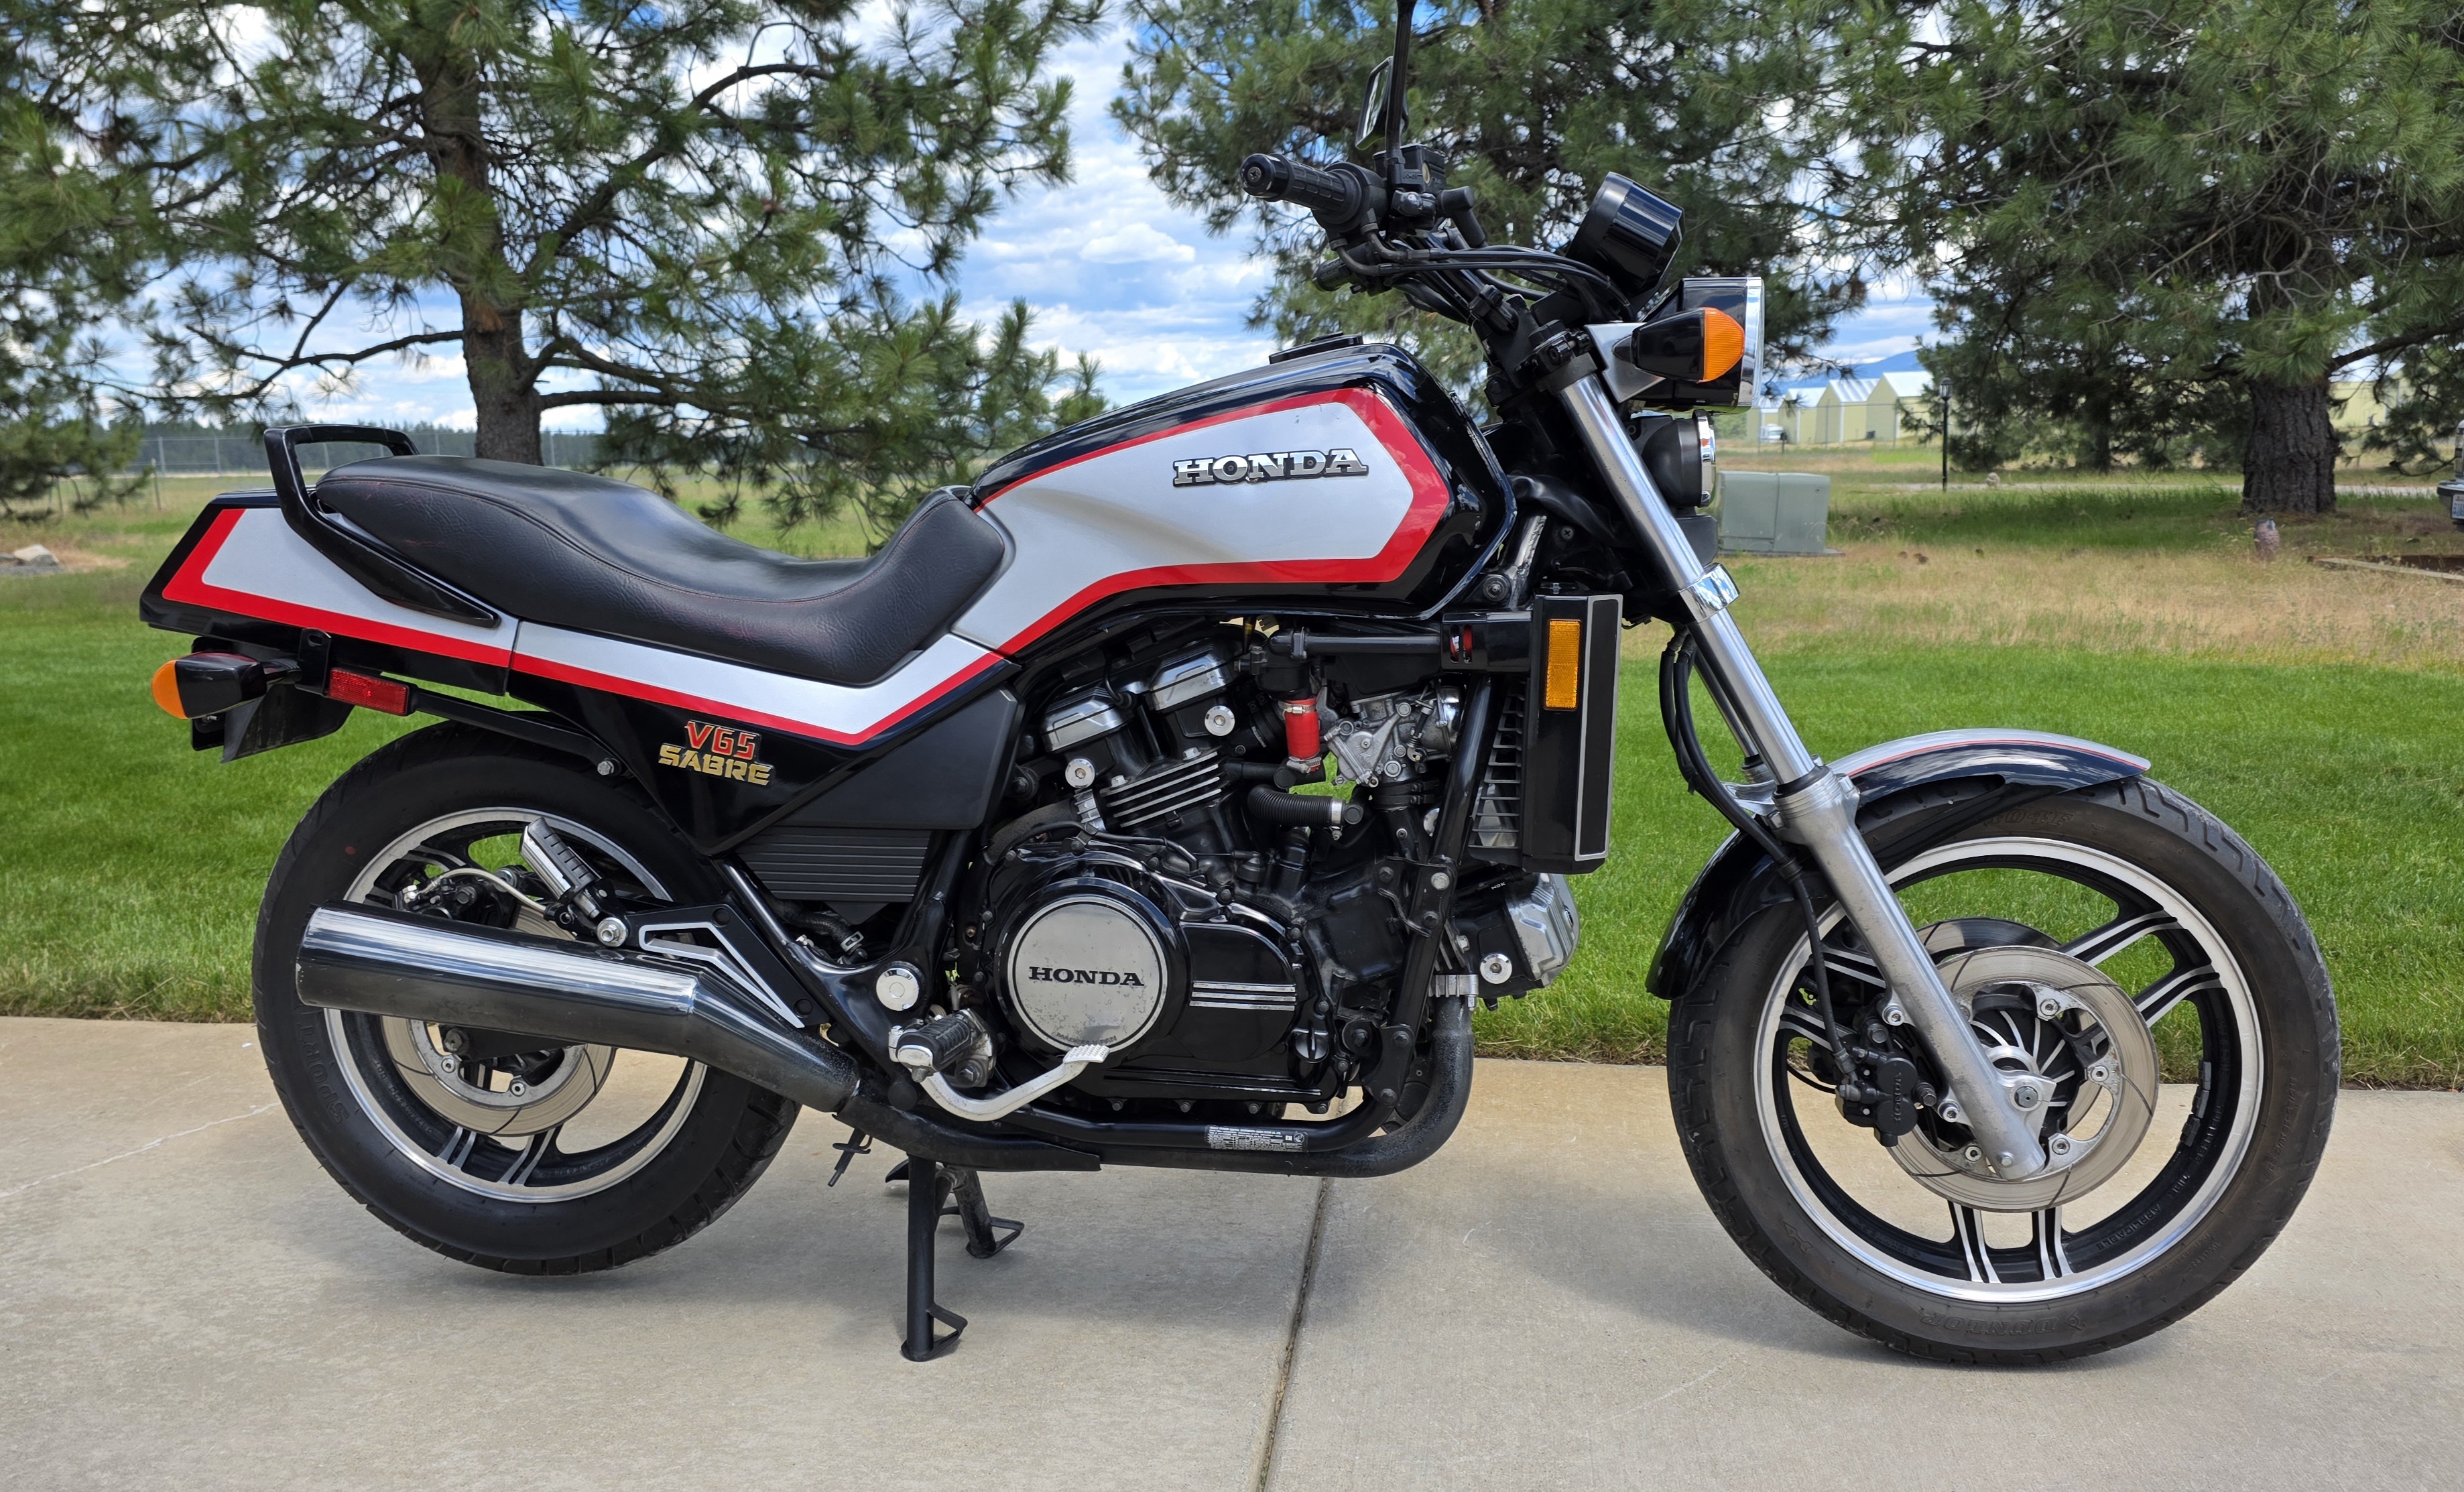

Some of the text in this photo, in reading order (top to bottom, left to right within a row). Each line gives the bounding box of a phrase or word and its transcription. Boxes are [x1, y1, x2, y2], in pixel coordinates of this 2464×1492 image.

[1174, 448, 1369, 487] HONDA
[684, 721, 757, 761] V65
[658, 745, 772, 786] SABRE
[1029, 967, 1144, 987] HONDA
[1056, 1032, 1081, 1045] MADE
[297, 1021, 351, 1129] SPORT
[1920, 1312, 2058, 1336] DUNLOP
